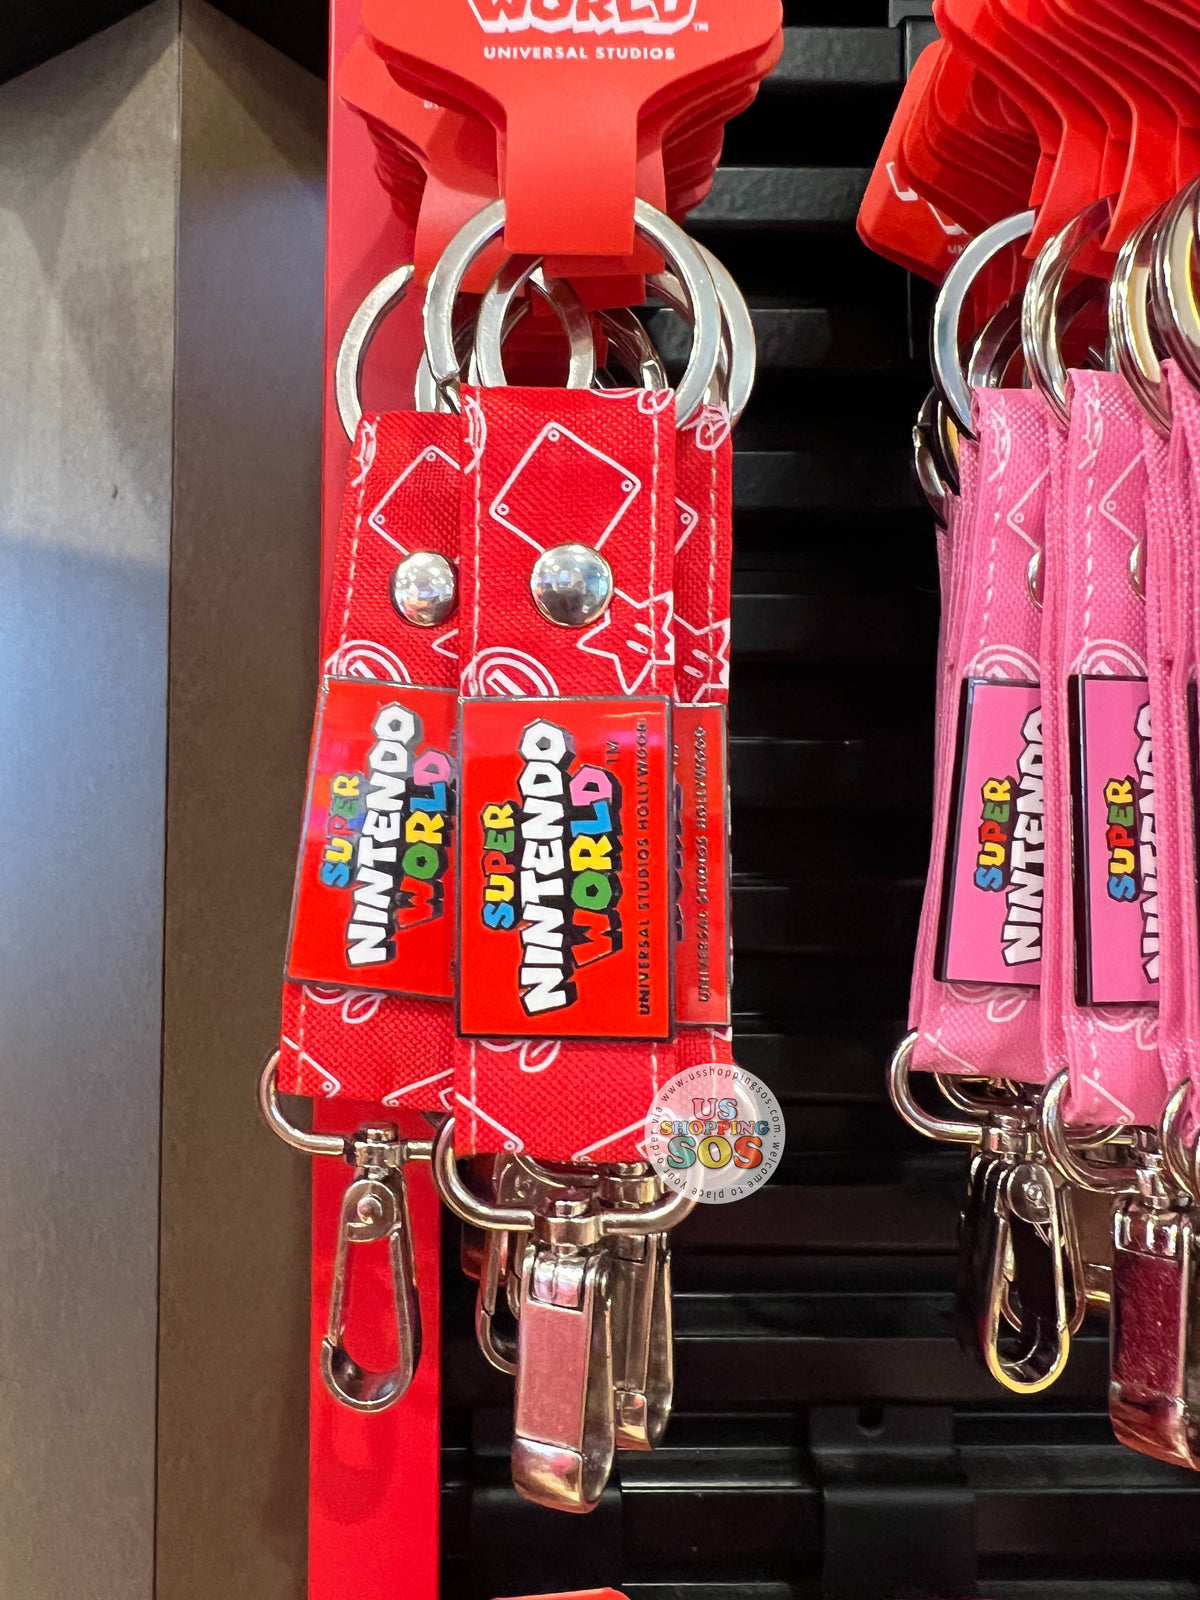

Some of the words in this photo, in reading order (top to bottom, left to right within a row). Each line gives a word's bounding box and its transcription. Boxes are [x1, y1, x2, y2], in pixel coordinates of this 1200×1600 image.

[484, 46, 588, 60] UNIVERSAL
[595, 47, 675, 60] STUDIOS
[320, 774, 361, 888] SUPER
[347, 702, 416, 965] NINTENDO
[635, 718, 650, 831] HOLLYWOOD
[974, 777, 1012, 890] SUPER
[397, 749, 452, 928] WORLD
[481, 802, 515, 929] SUPER
[518, 718, 569, 1014] NINTENDO
[568, 764, 615, 966] WORLD
[637, 838, 650, 910] STUDIOS
[1105, 778, 1137, 901] SUPER
[638, 918, 651, 1016] UNIVERSAL
